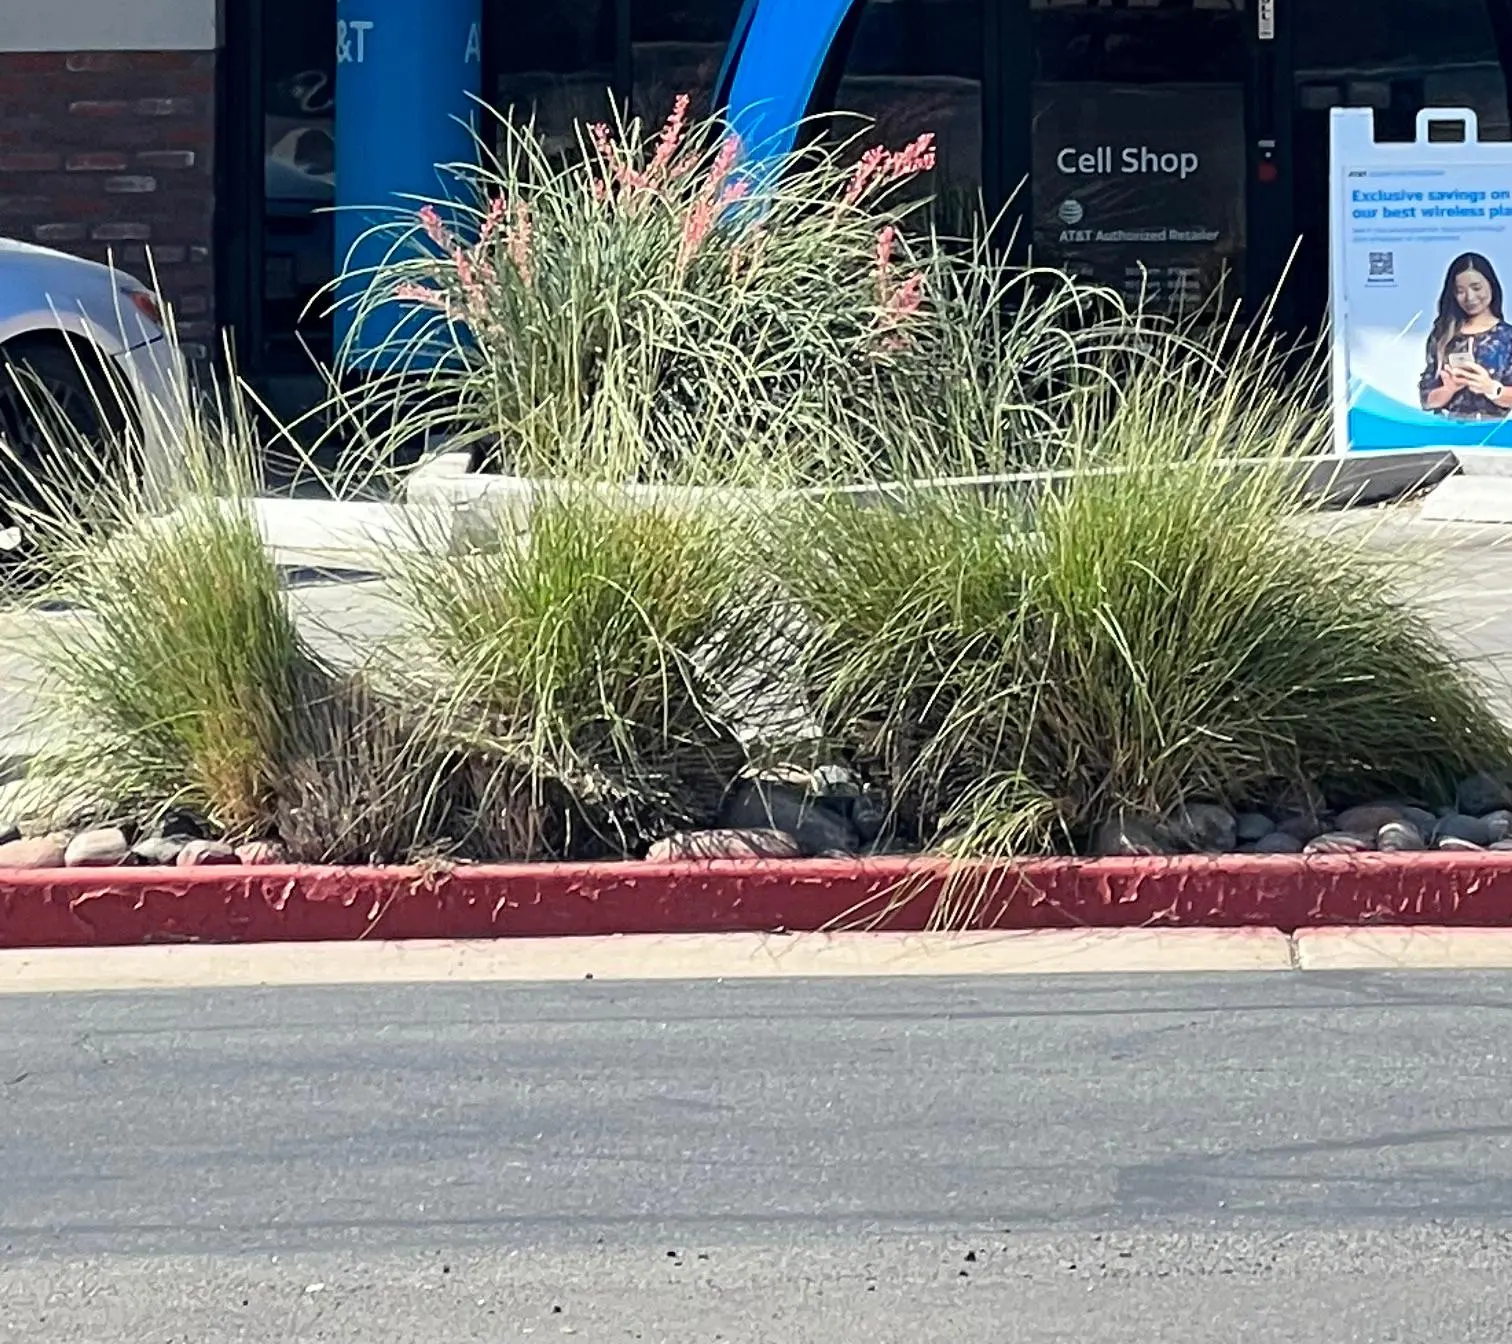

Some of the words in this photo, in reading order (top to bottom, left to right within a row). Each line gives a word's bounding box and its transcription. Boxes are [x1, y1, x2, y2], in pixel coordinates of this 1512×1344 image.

[1057, 146, 1112, 173] Cell
[1121, 146, 1198, 179] Shop
[1352, 189, 1424, 202] Exclusive
[1428, 188, 1486, 203] savings
[1490, 191, 1510, 200] on
[1352, 208, 1378, 219] our
[1383, 206, 1416, 218] best
[1421, 205, 1485, 217] wireless
[1059, 230, 1094, 242] AT&T
